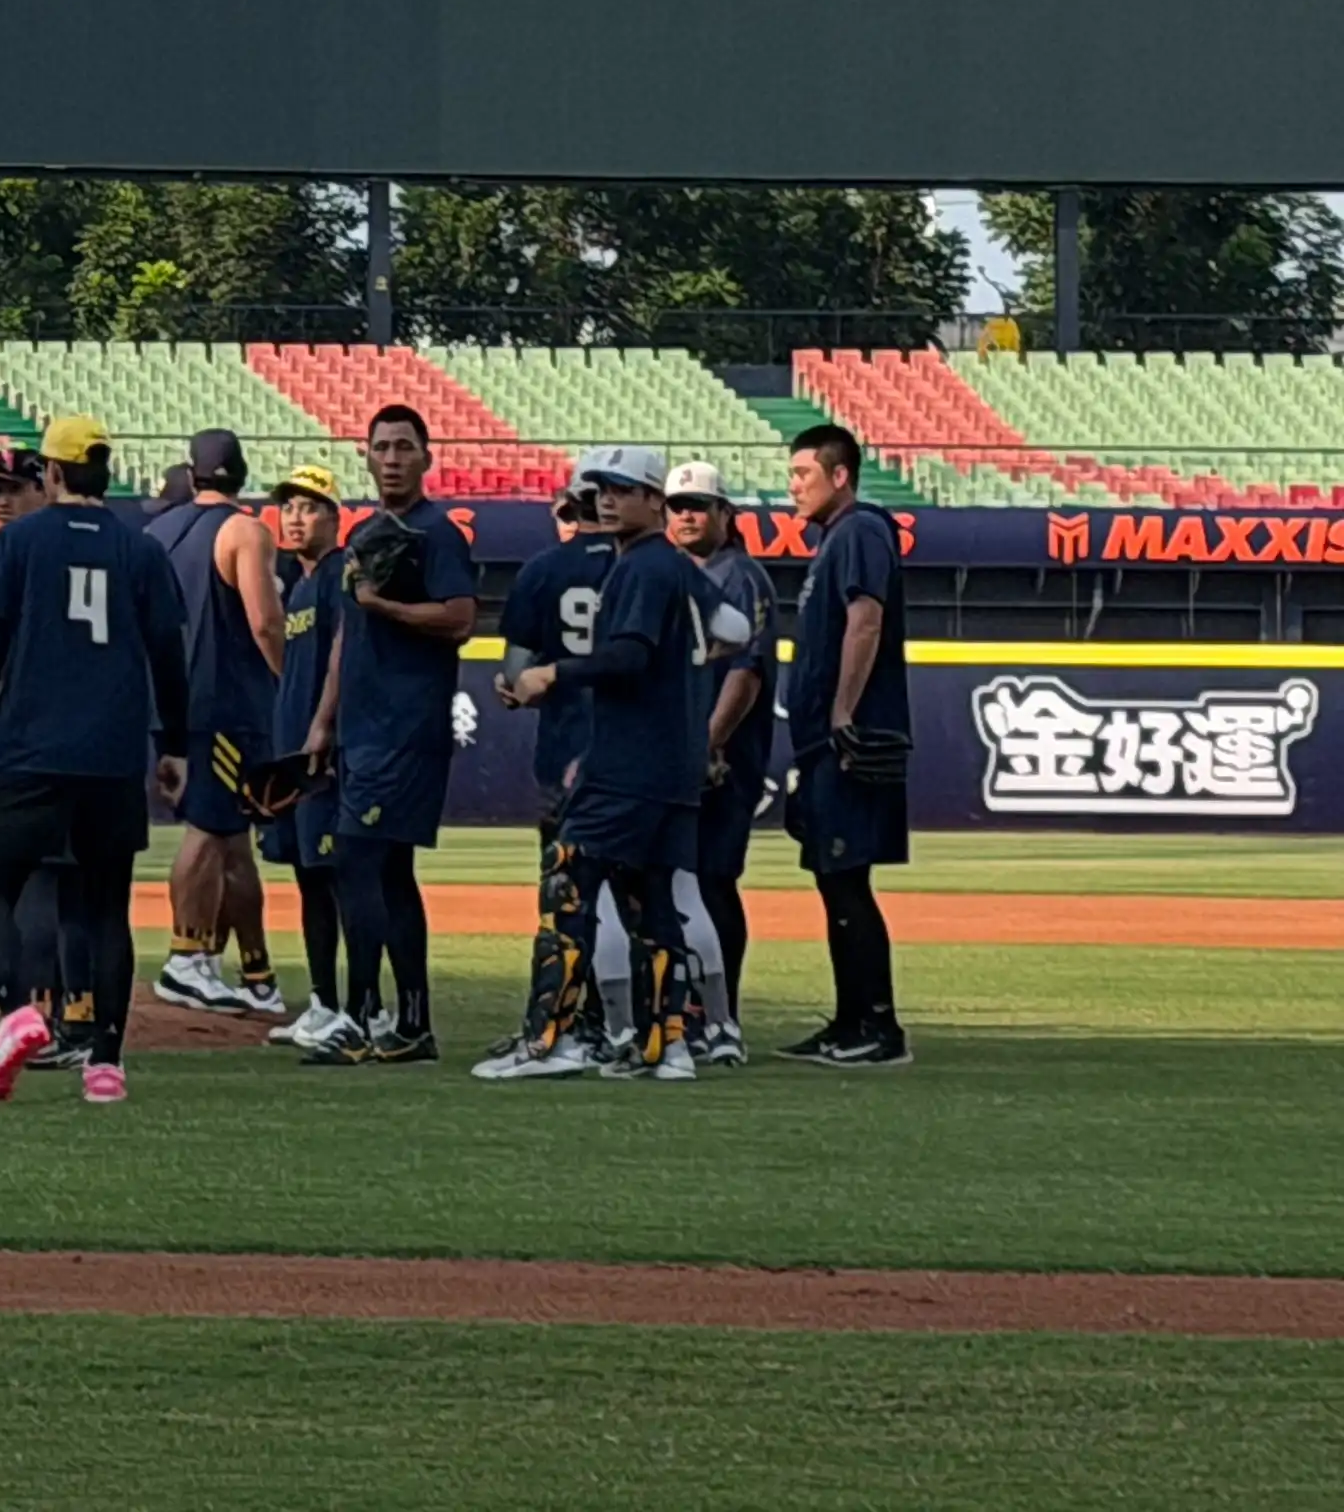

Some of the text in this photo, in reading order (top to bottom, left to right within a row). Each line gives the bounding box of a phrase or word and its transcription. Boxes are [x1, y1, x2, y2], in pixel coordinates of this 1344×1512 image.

[67, 565, 109, 644] 4
[983, 687, 1310, 796] 金好運
